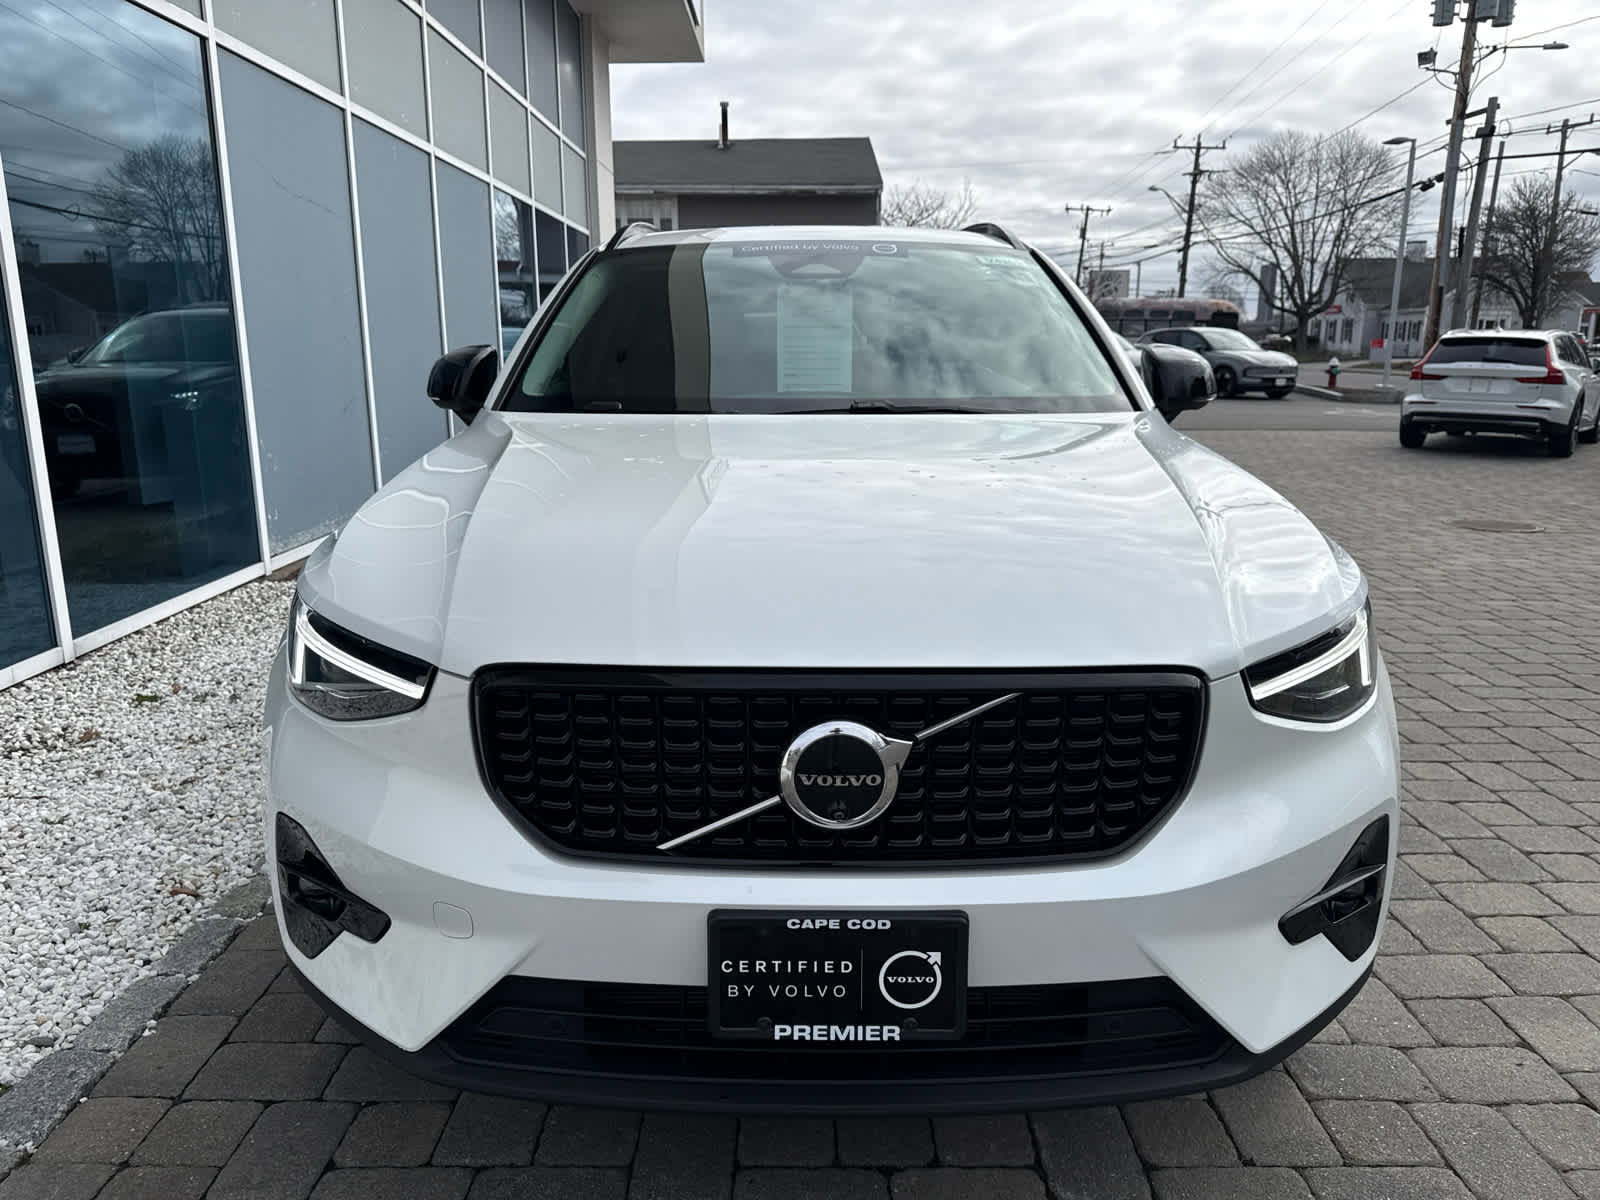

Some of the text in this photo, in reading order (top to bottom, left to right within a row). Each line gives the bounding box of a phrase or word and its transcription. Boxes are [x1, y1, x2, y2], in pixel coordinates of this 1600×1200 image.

[798, 774, 882, 786] VOLVO
[786, 919, 892, 930] CAPE COD
[721, 960, 853, 973] CERTIFIED
[727, 985, 846, 998] BY VOLVO
[774, 1025, 901, 1041] PREMIER
